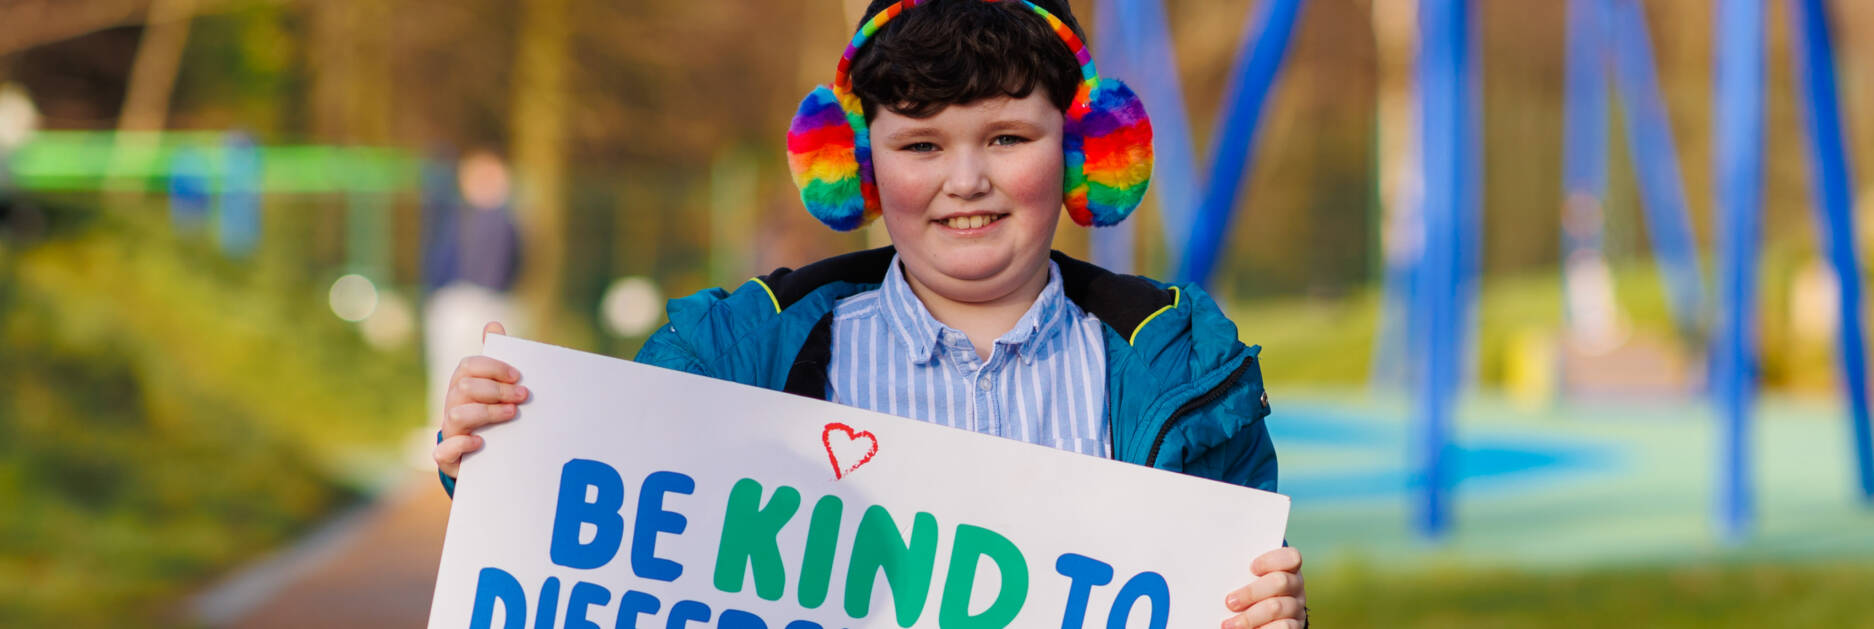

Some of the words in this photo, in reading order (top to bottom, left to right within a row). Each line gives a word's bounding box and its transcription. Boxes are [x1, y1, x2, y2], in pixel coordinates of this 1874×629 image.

[549, 457, 696, 583] BE
[713, 477, 1030, 629] KIND
[1055, 552, 1171, 629] TO
